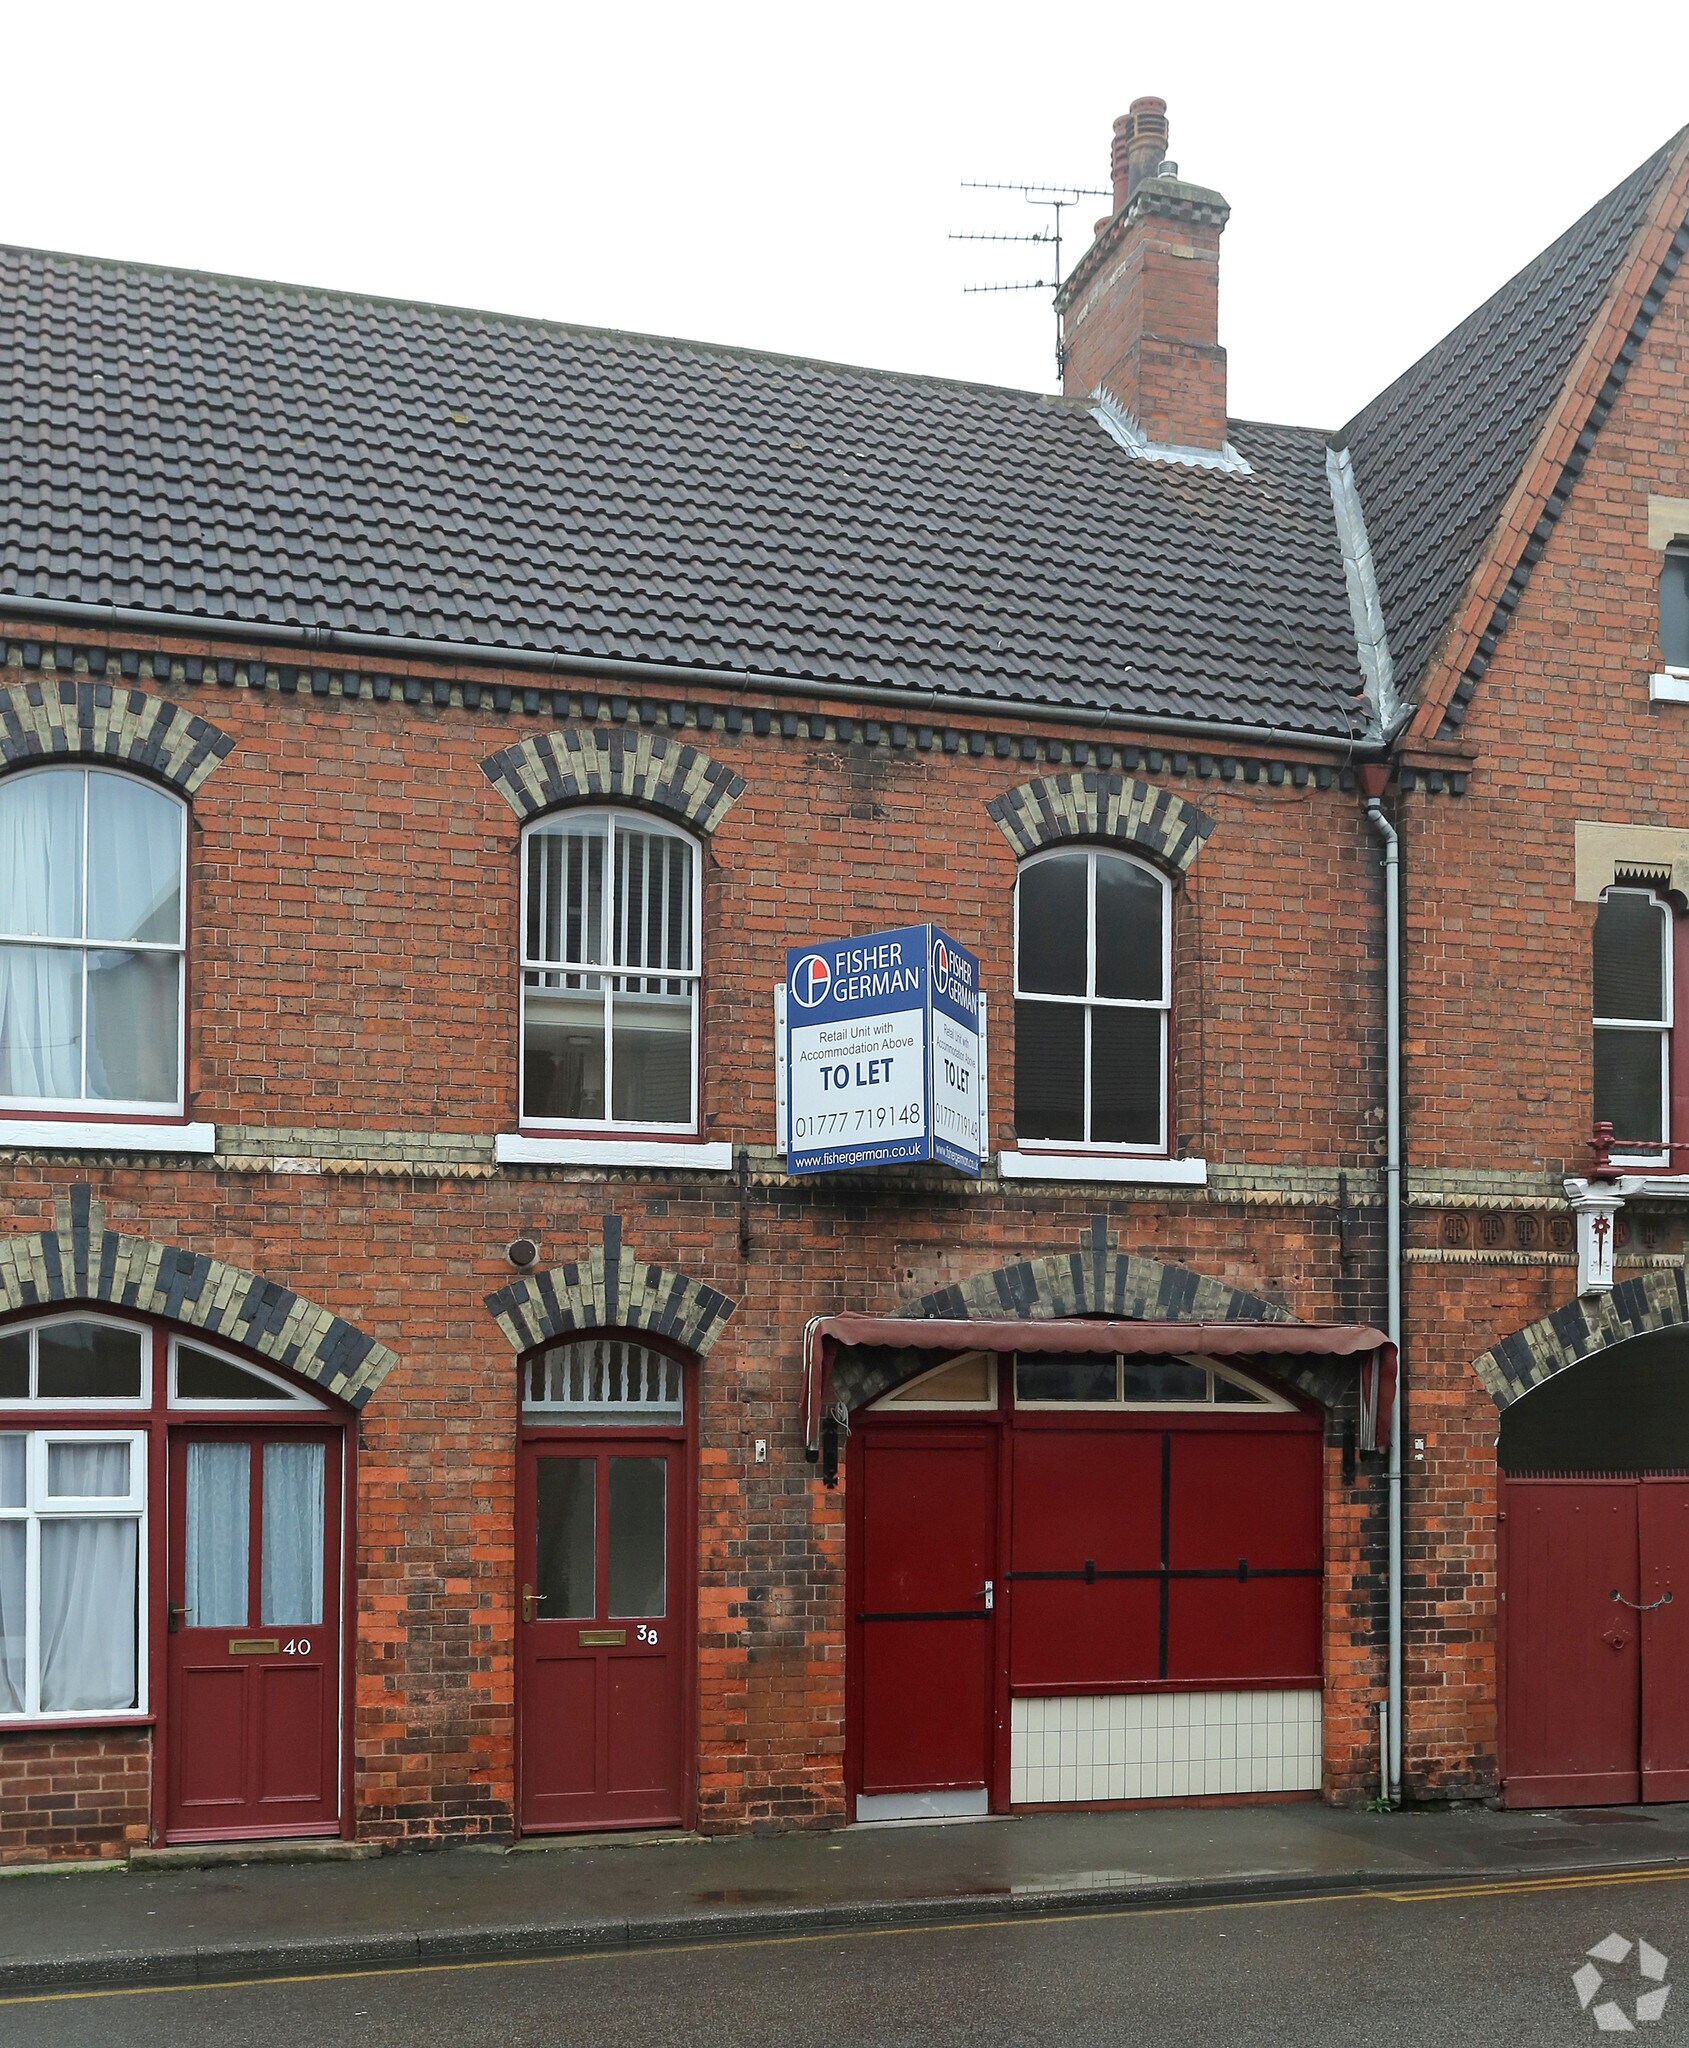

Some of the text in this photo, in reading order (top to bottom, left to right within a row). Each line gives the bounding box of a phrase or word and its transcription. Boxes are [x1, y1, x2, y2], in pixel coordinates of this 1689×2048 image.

[835, 942, 903, 976] FISHER
[948, 949, 972, 987] FISHER
[832, 965, 920, 1002] GERMAN
[947, 976, 977, 1016] GERMAN
[799, 1036, 915, 1062] Accommodation Above
[819, 1021, 894, 1044] Retail Unit with
[820, 1057, 894, 1091] TO LET
[944, 1058, 970, 1095] TO LET
[795, 1102, 921, 1138] 01777 719148
[935, 1102, 979, 1142] 01777 719148
[794, 1142, 922, 1168] www.fishergerman.co.uk
[282, 1638, 311, 1656] 40
[636, 1624, 658, 1645] 38
